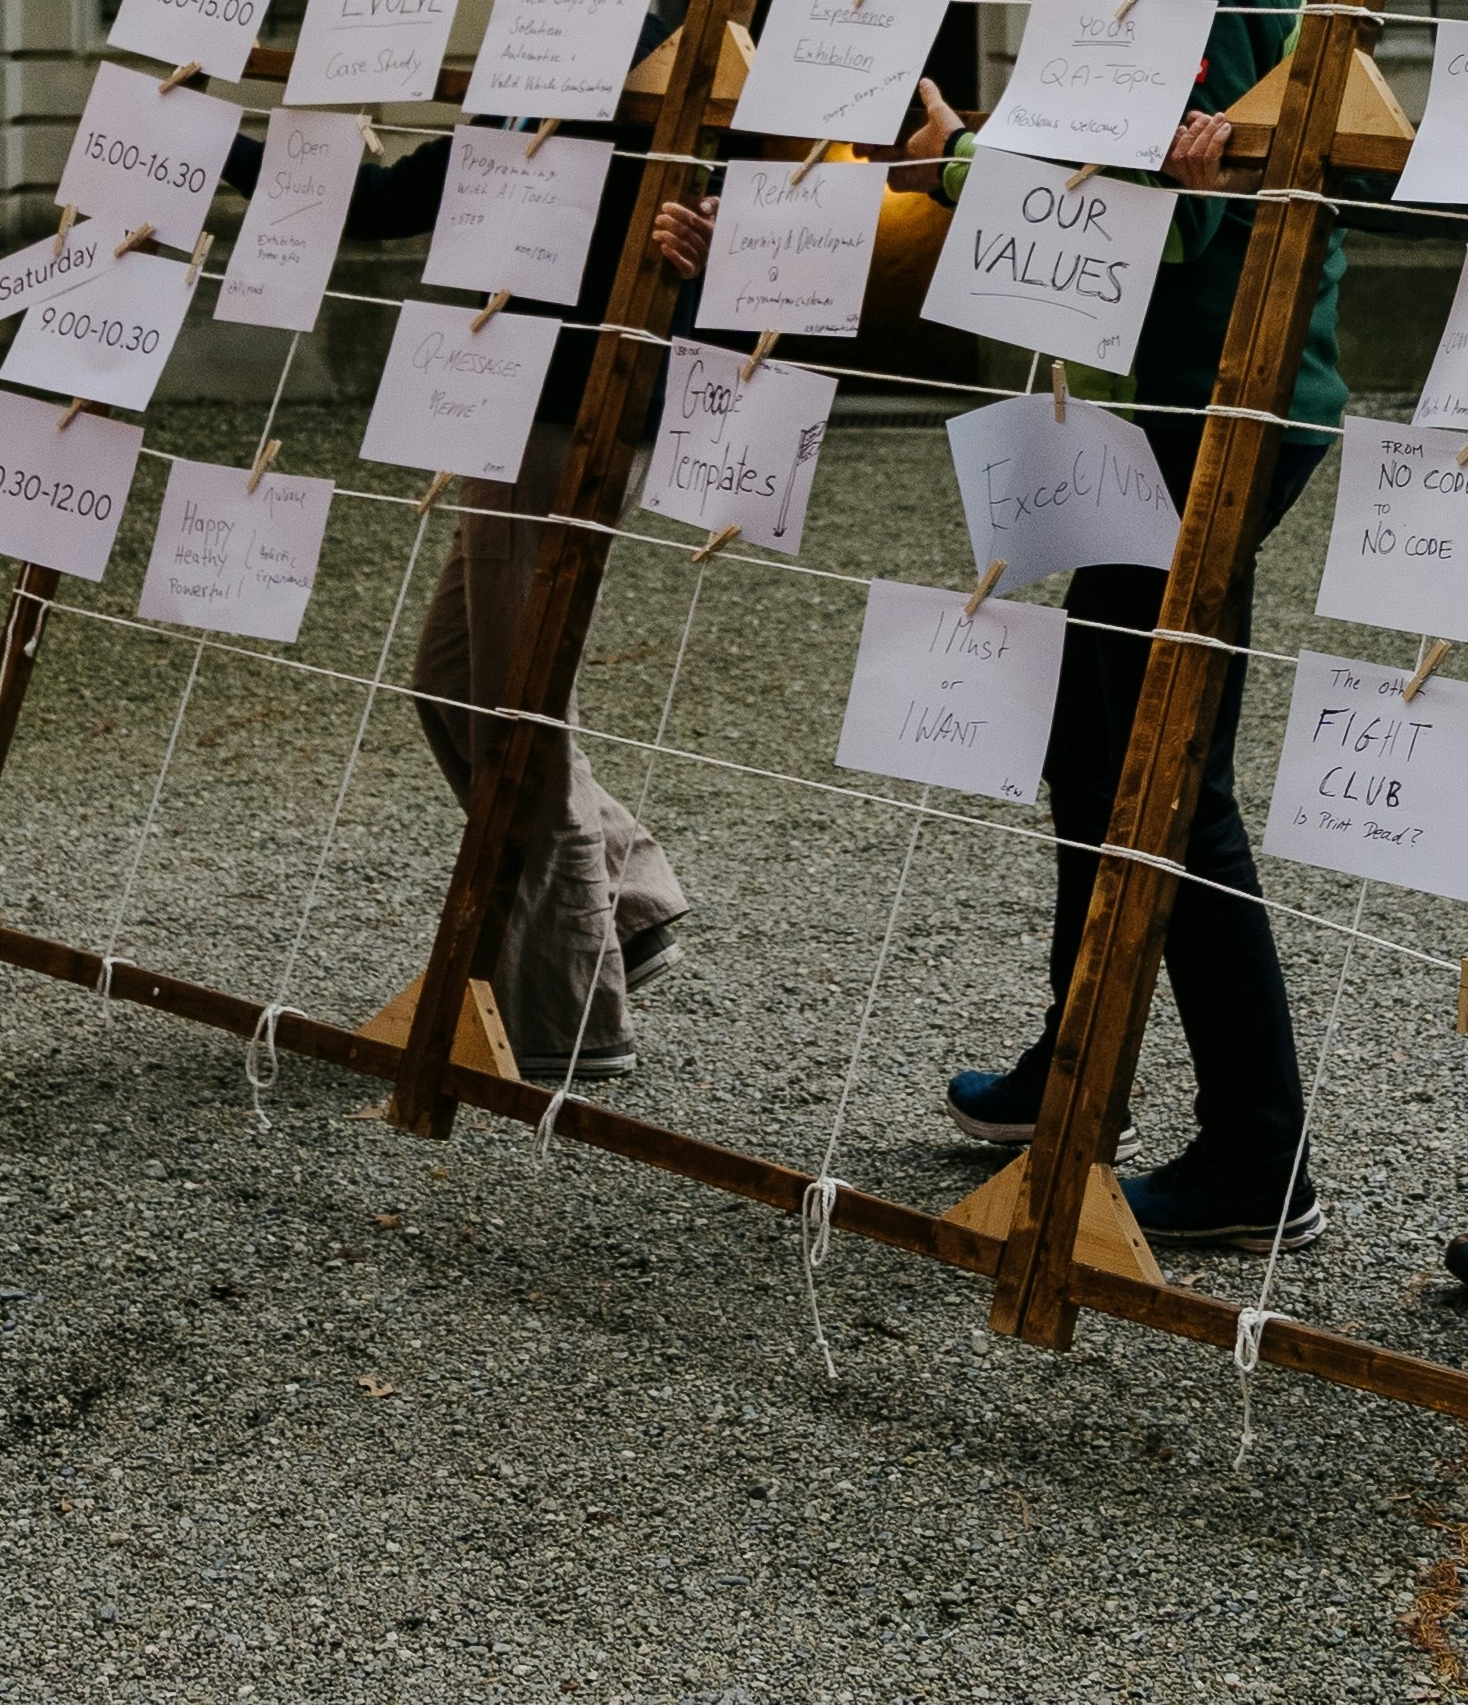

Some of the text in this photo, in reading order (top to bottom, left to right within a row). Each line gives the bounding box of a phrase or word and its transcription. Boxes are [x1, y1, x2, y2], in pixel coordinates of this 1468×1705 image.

[794, 38, 874, 69] Exhibition
[84, 131, 207, 194] 15.00-16.30
[288, 129, 330, 165] Open
[268, 171, 325, 199] Studio
[1021, 186, 1112, 242] OUR
[975, 229, 1130, 305] VALUES
[40, 307, 161, 355] 9.00-10.30
[1382, 439, 1424, 460] FROM
[669, 429, 777, 517] Templates
[1378, 460, 1411, 490] NO
[181, 499, 236, 553] Happy
[1361, 528, 1397, 556] NO
[1405, 534, 1454, 560] CODE
[953, 617, 1011, 660] Must
[1330, 667, 1362, 694] The
[915, 708, 988, 748] WANT
[1313, 708, 1433, 762] FIGHT
[1318, 766, 1402, 808] CLUB
[1318, 810, 1353, 833] Print
[1363, 821, 1424, 846] Dead?
